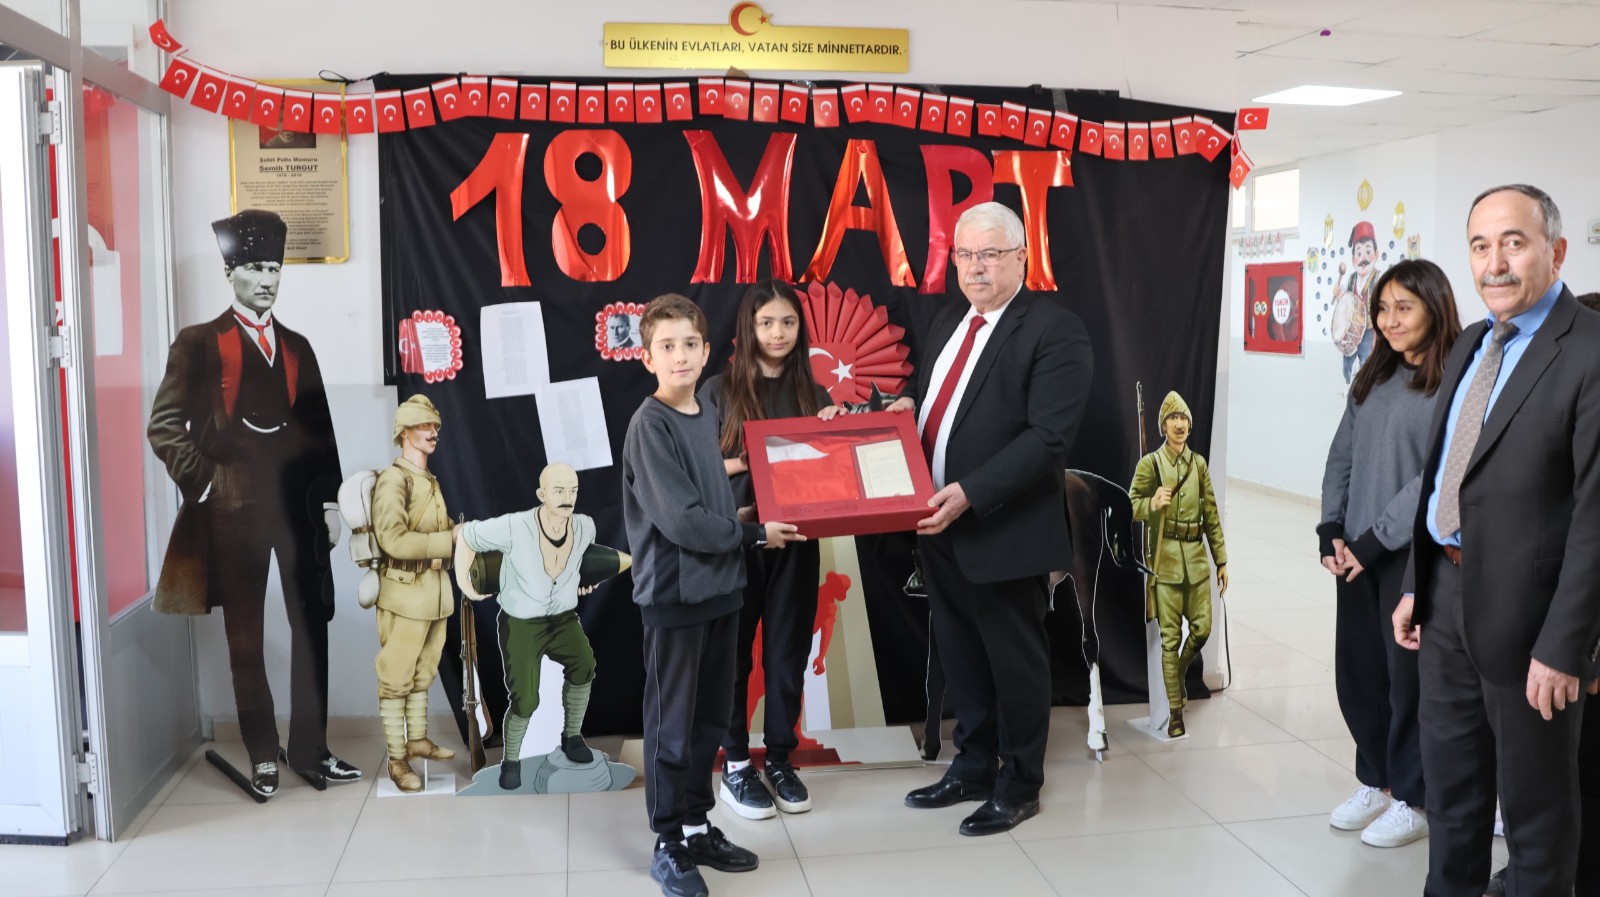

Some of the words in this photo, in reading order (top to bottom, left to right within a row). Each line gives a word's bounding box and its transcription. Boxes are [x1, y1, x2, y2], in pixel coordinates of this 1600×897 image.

[610, 39, 625, 50] BU
[629, 37, 678, 51] ÜLKENİN
[682, 40, 745, 53] EVLATLARI,
[748, 42, 788, 53] VATAN
[792, 40, 814, 53] SİZE
[817, 41, 902, 55] MİNNETTARDIR.
[450, 129, 632, 287] 18
[682, 129, 1075, 295] MART
[1277, 308, 1286, 318] 112
